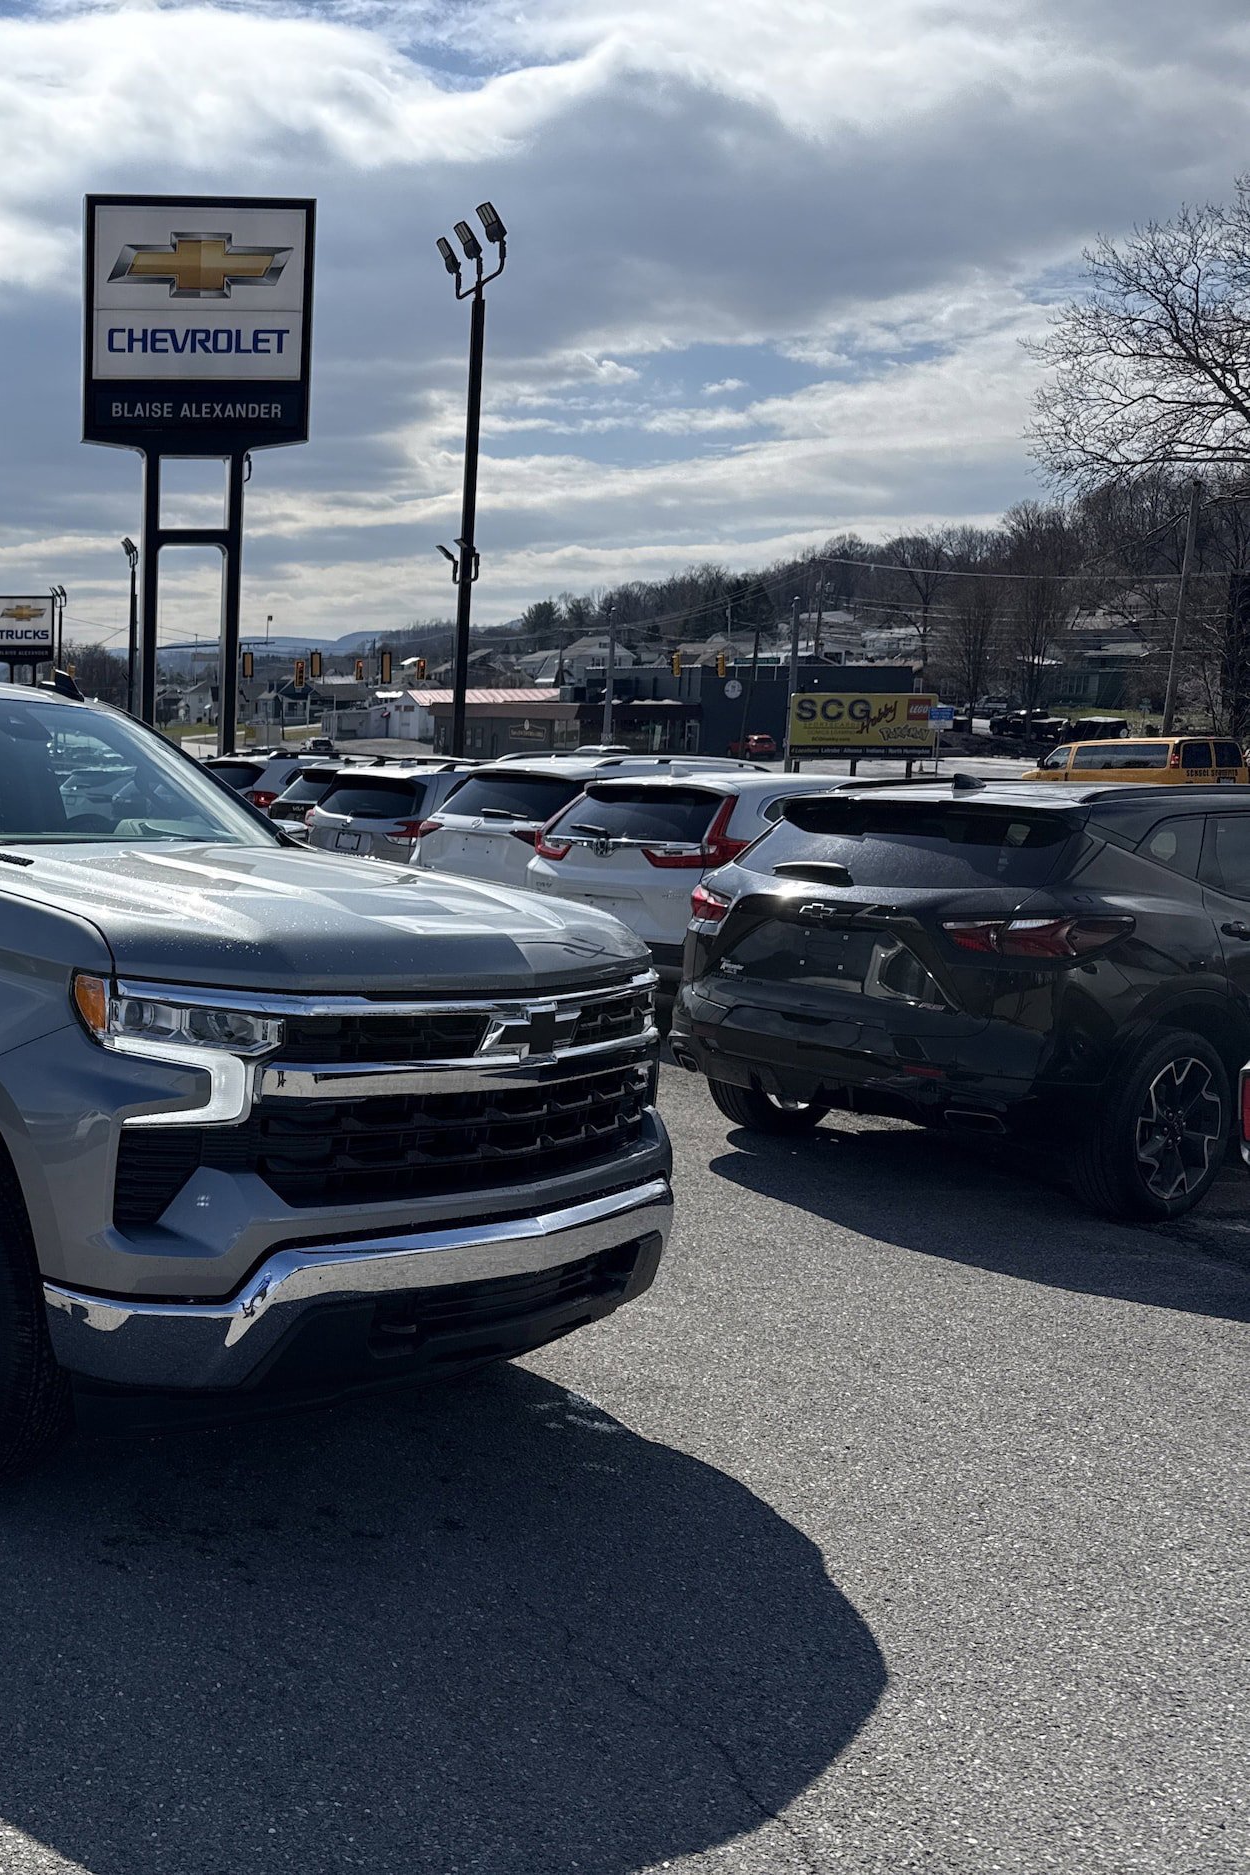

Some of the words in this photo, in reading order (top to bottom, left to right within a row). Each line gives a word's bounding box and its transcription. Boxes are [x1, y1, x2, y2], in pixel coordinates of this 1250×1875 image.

[107, 327, 290, 354] CHEVROLET
[111, 402, 173, 418] BLAISE
[180, 402, 282, 419] ALEXANDER
[796, 698, 872, 722] SCG
[856, 700, 898, 734] Hobby
[909, 705, 929, 714] LEGO
